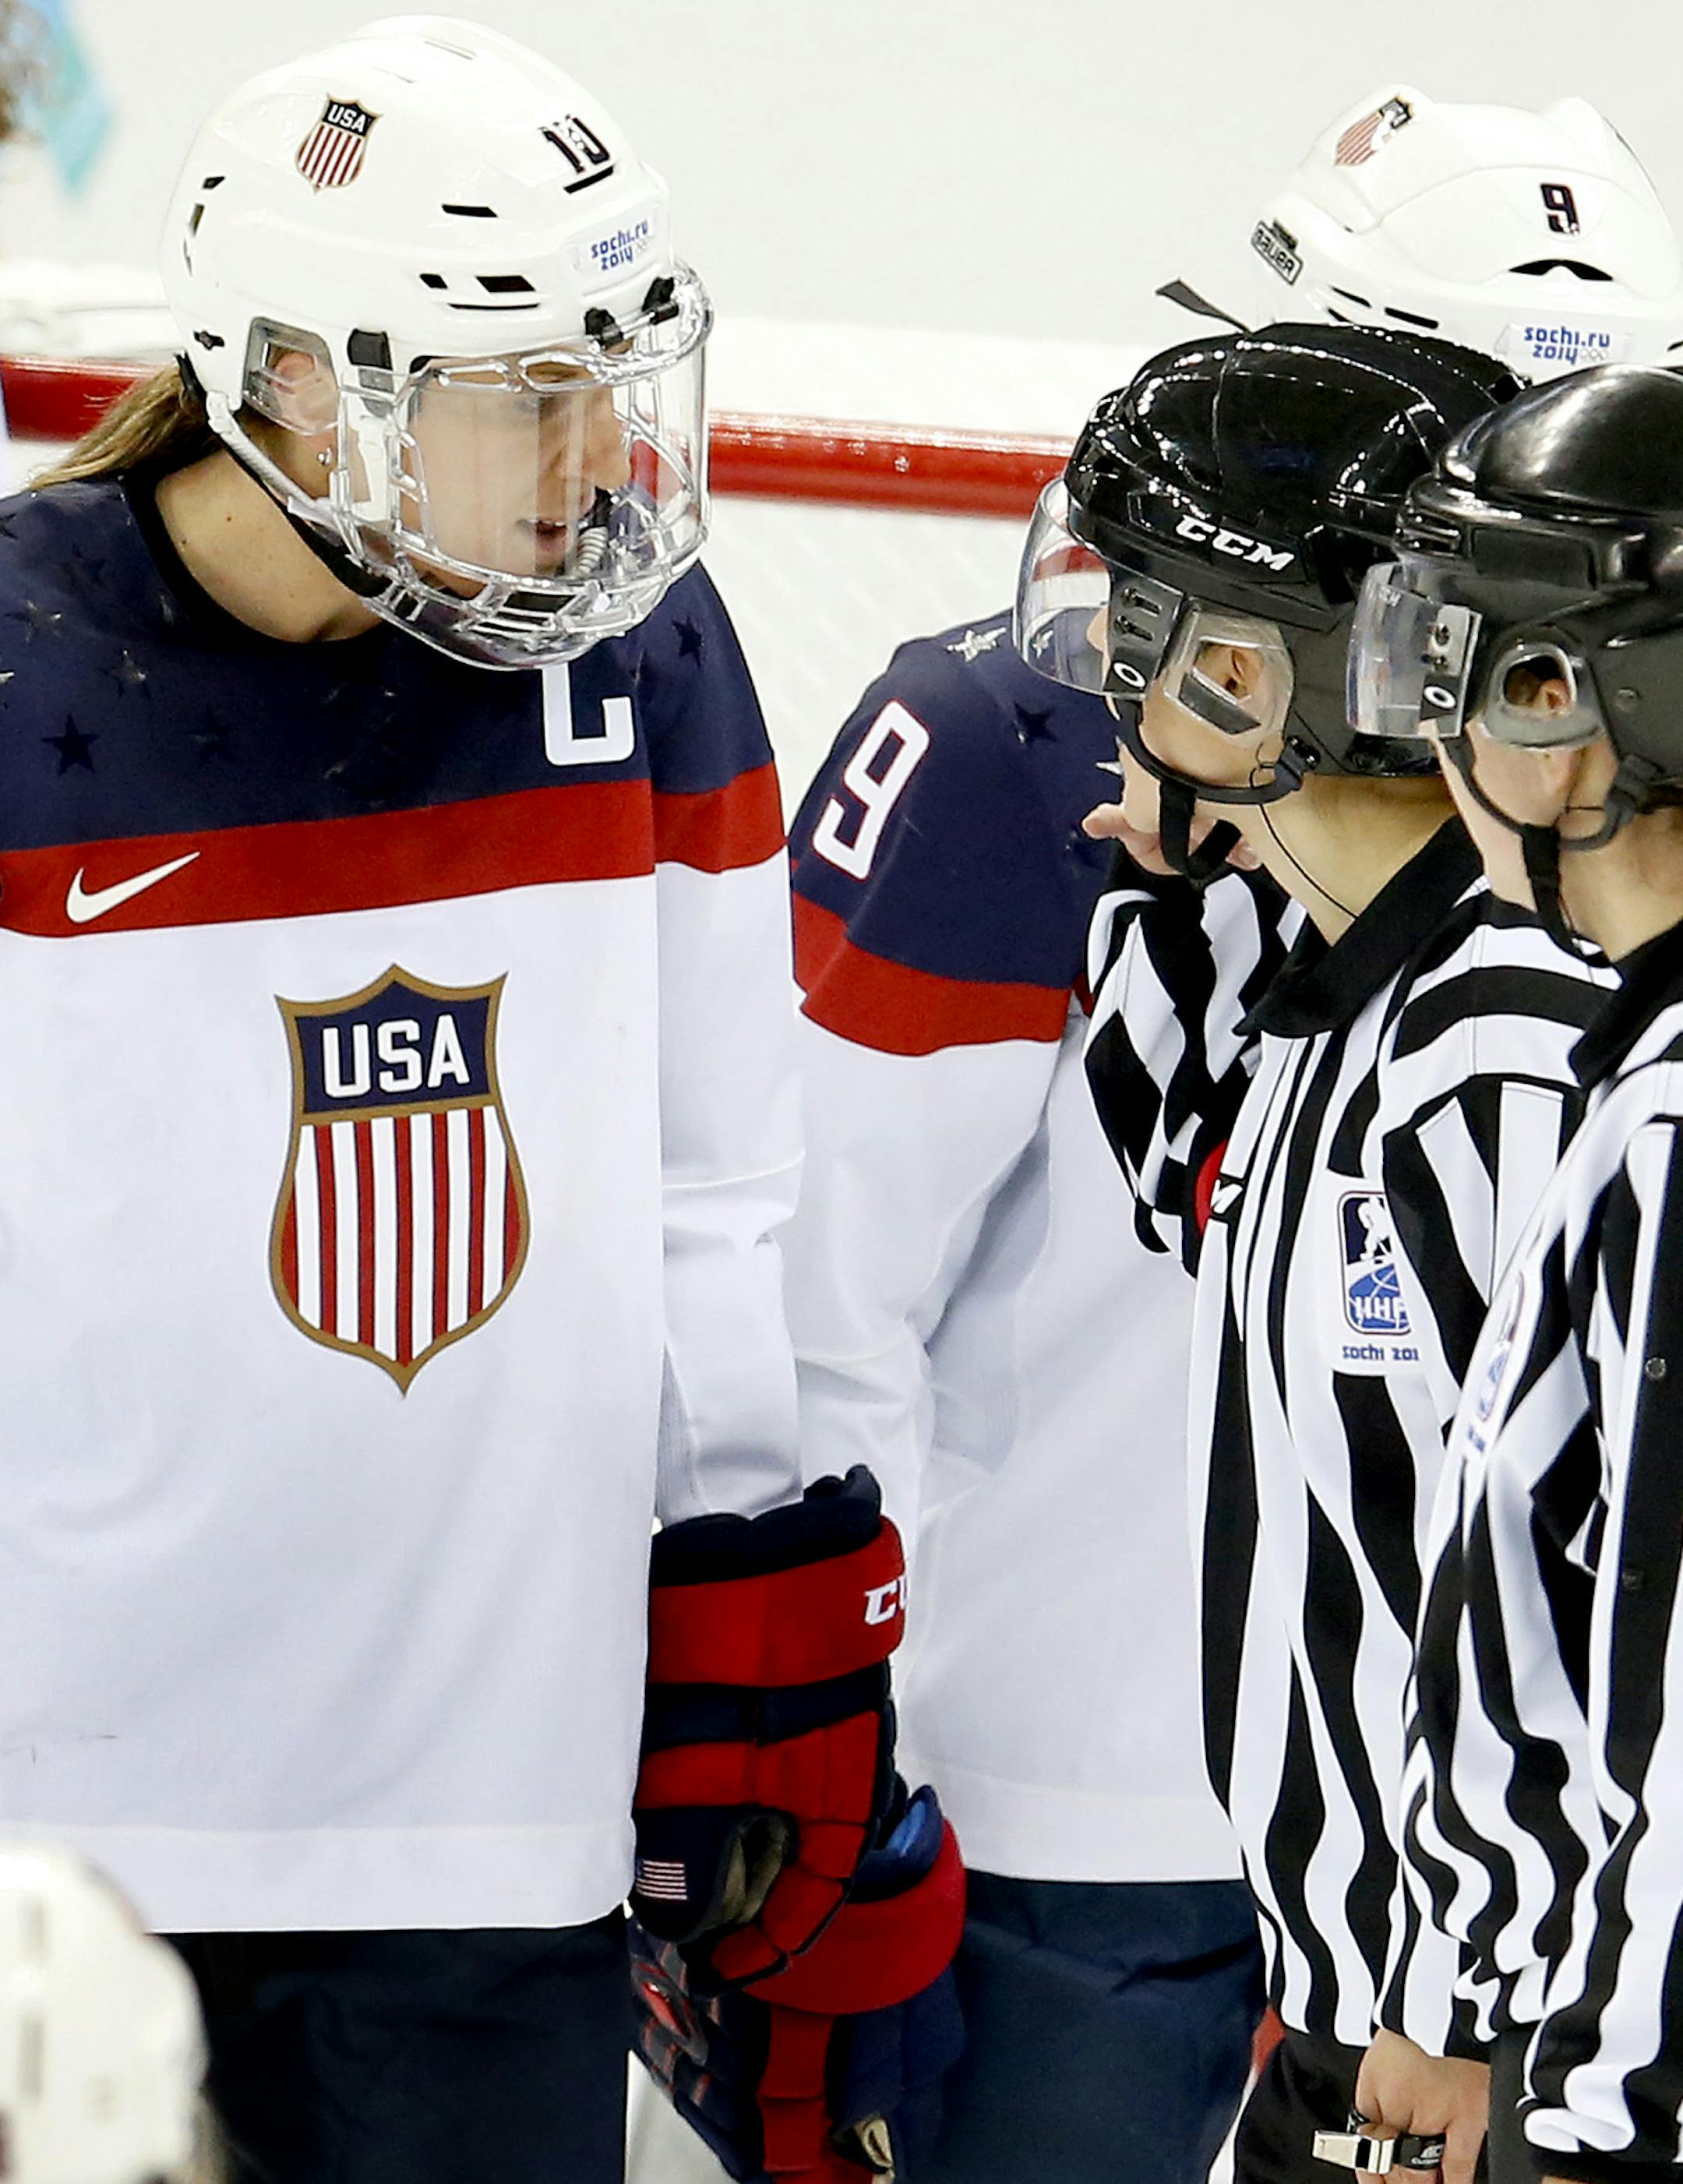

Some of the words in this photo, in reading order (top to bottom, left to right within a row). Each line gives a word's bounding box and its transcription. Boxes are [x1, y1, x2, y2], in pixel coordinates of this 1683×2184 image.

[327, 104, 366, 132] USA
[1540, 182, 1580, 235] 9
[591, 218, 648, 259] sochi.ru
[601, 245, 633, 270] 2014
[1524, 326, 1610, 348] sochi.ru
[1533, 344, 1578, 365] 2014
[1175, 514, 1295, 571] CCM
[542, 661, 635, 767] C
[813, 699, 931, 881] 9
[323, 1014, 470, 1099] USA
[1343, 1342, 1385, 1360] sochi
